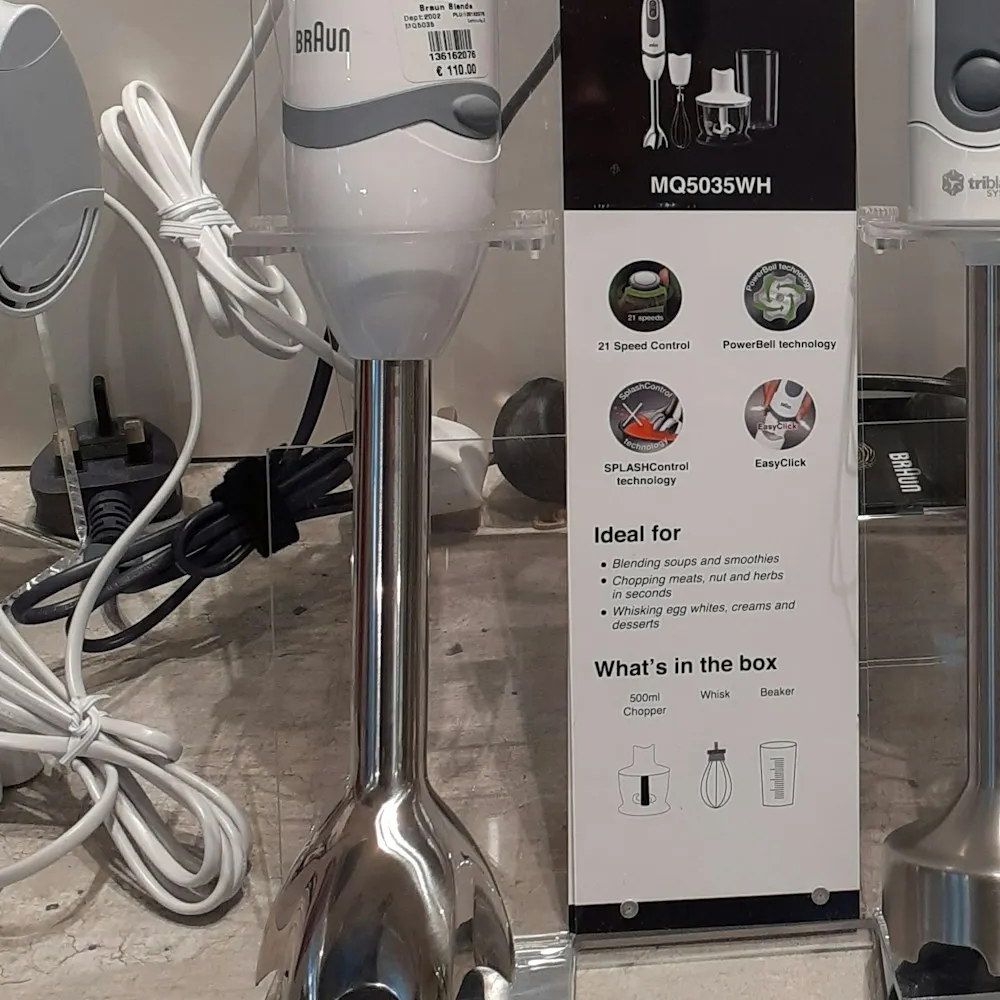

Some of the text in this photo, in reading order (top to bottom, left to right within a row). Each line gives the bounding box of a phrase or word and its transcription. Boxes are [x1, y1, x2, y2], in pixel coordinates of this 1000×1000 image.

[429, 51, 476, 61] 136162076
[447, 64, 476, 75] 110.00
[651, 176, 772, 194] MQ5035WH
[638, 314, 664, 322] speeds
[598, 341, 690, 352] 21 Speed Control
[723, 340, 836, 350] PowerBell technology
[619, 382, 674, 401] SplashControl
[758, 423, 797, 431] EasyClick
[624, 438, 668, 450] technology
[605, 462, 689, 472] SPLASHControl
[755, 458, 806, 469] EasyClick
[617, 476, 676, 486] technology
[595, 525, 681, 543] Ideal for
[612, 554, 779, 570] Blending soups and smoothies
[612, 570, 783, 587] Chopping meats, nut and herbs
[612, 588, 672, 599] in seconds
[613, 600, 795, 617] Whisking egg whites, creams and
[612, 619, 659, 630] desserts
[674, 657, 693, 674] in
[701, 656, 733, 673] the
[740, 655, 777, 671] box
[700, 690, 730, 699] Whisk
[760, 687, 795, 697] Beaker
[630, 693, 660, 703] 500ml
[623, 706, 666, 717] Chopper
